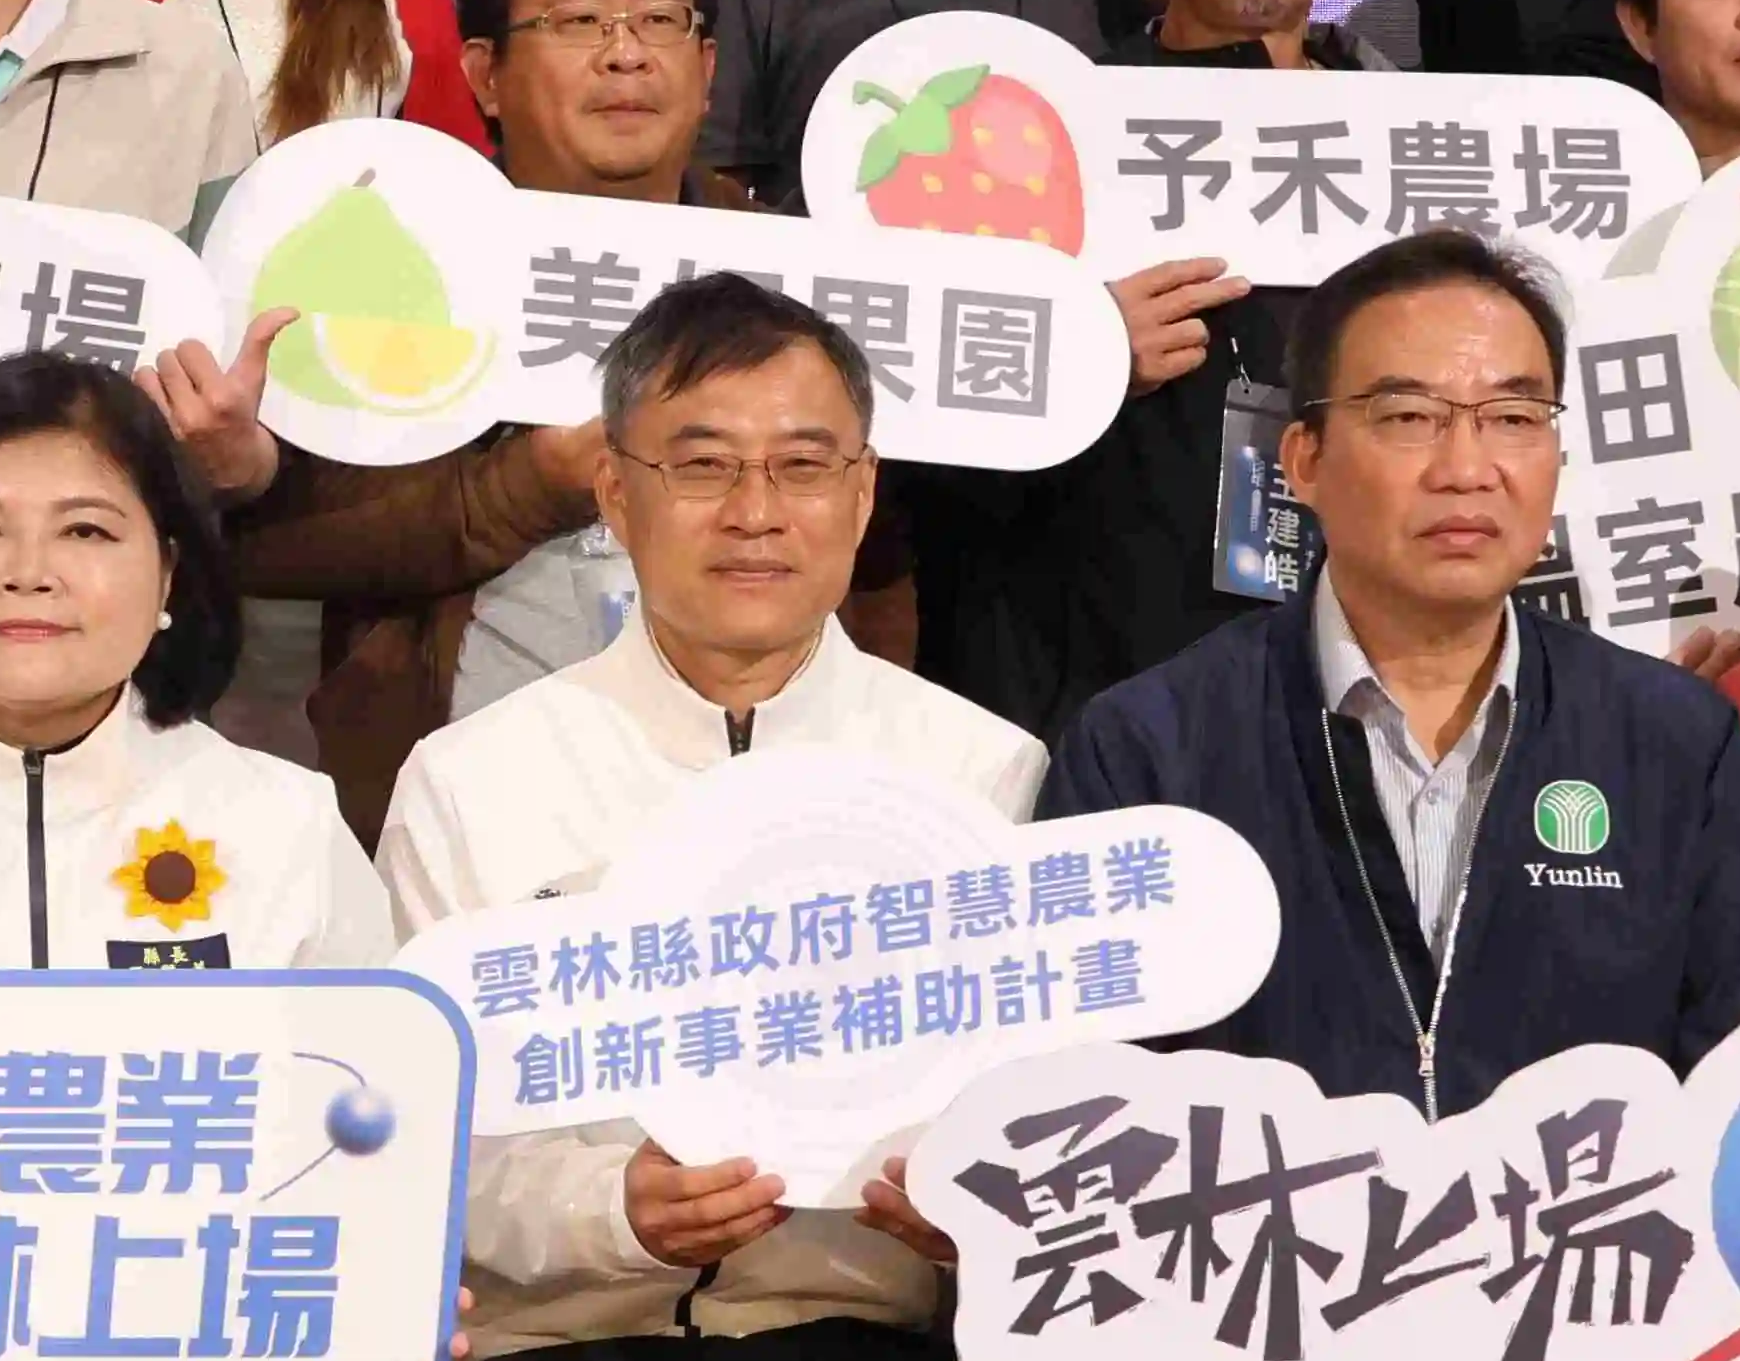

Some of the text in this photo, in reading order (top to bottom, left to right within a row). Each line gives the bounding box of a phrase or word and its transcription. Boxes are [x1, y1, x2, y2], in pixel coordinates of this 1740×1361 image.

[1117, 117, 1632, 242] 予禾農場
[517, 246, 1053, 418] 美果園
[1558, 333, 1692, 466] 田
[470, 836, 1176, 1022] 雲林縣政府智慧農業
[1524, 863, 1623, 889] Yunlin
[513, 938, 1149, 1108] 創新事業補助計畫
